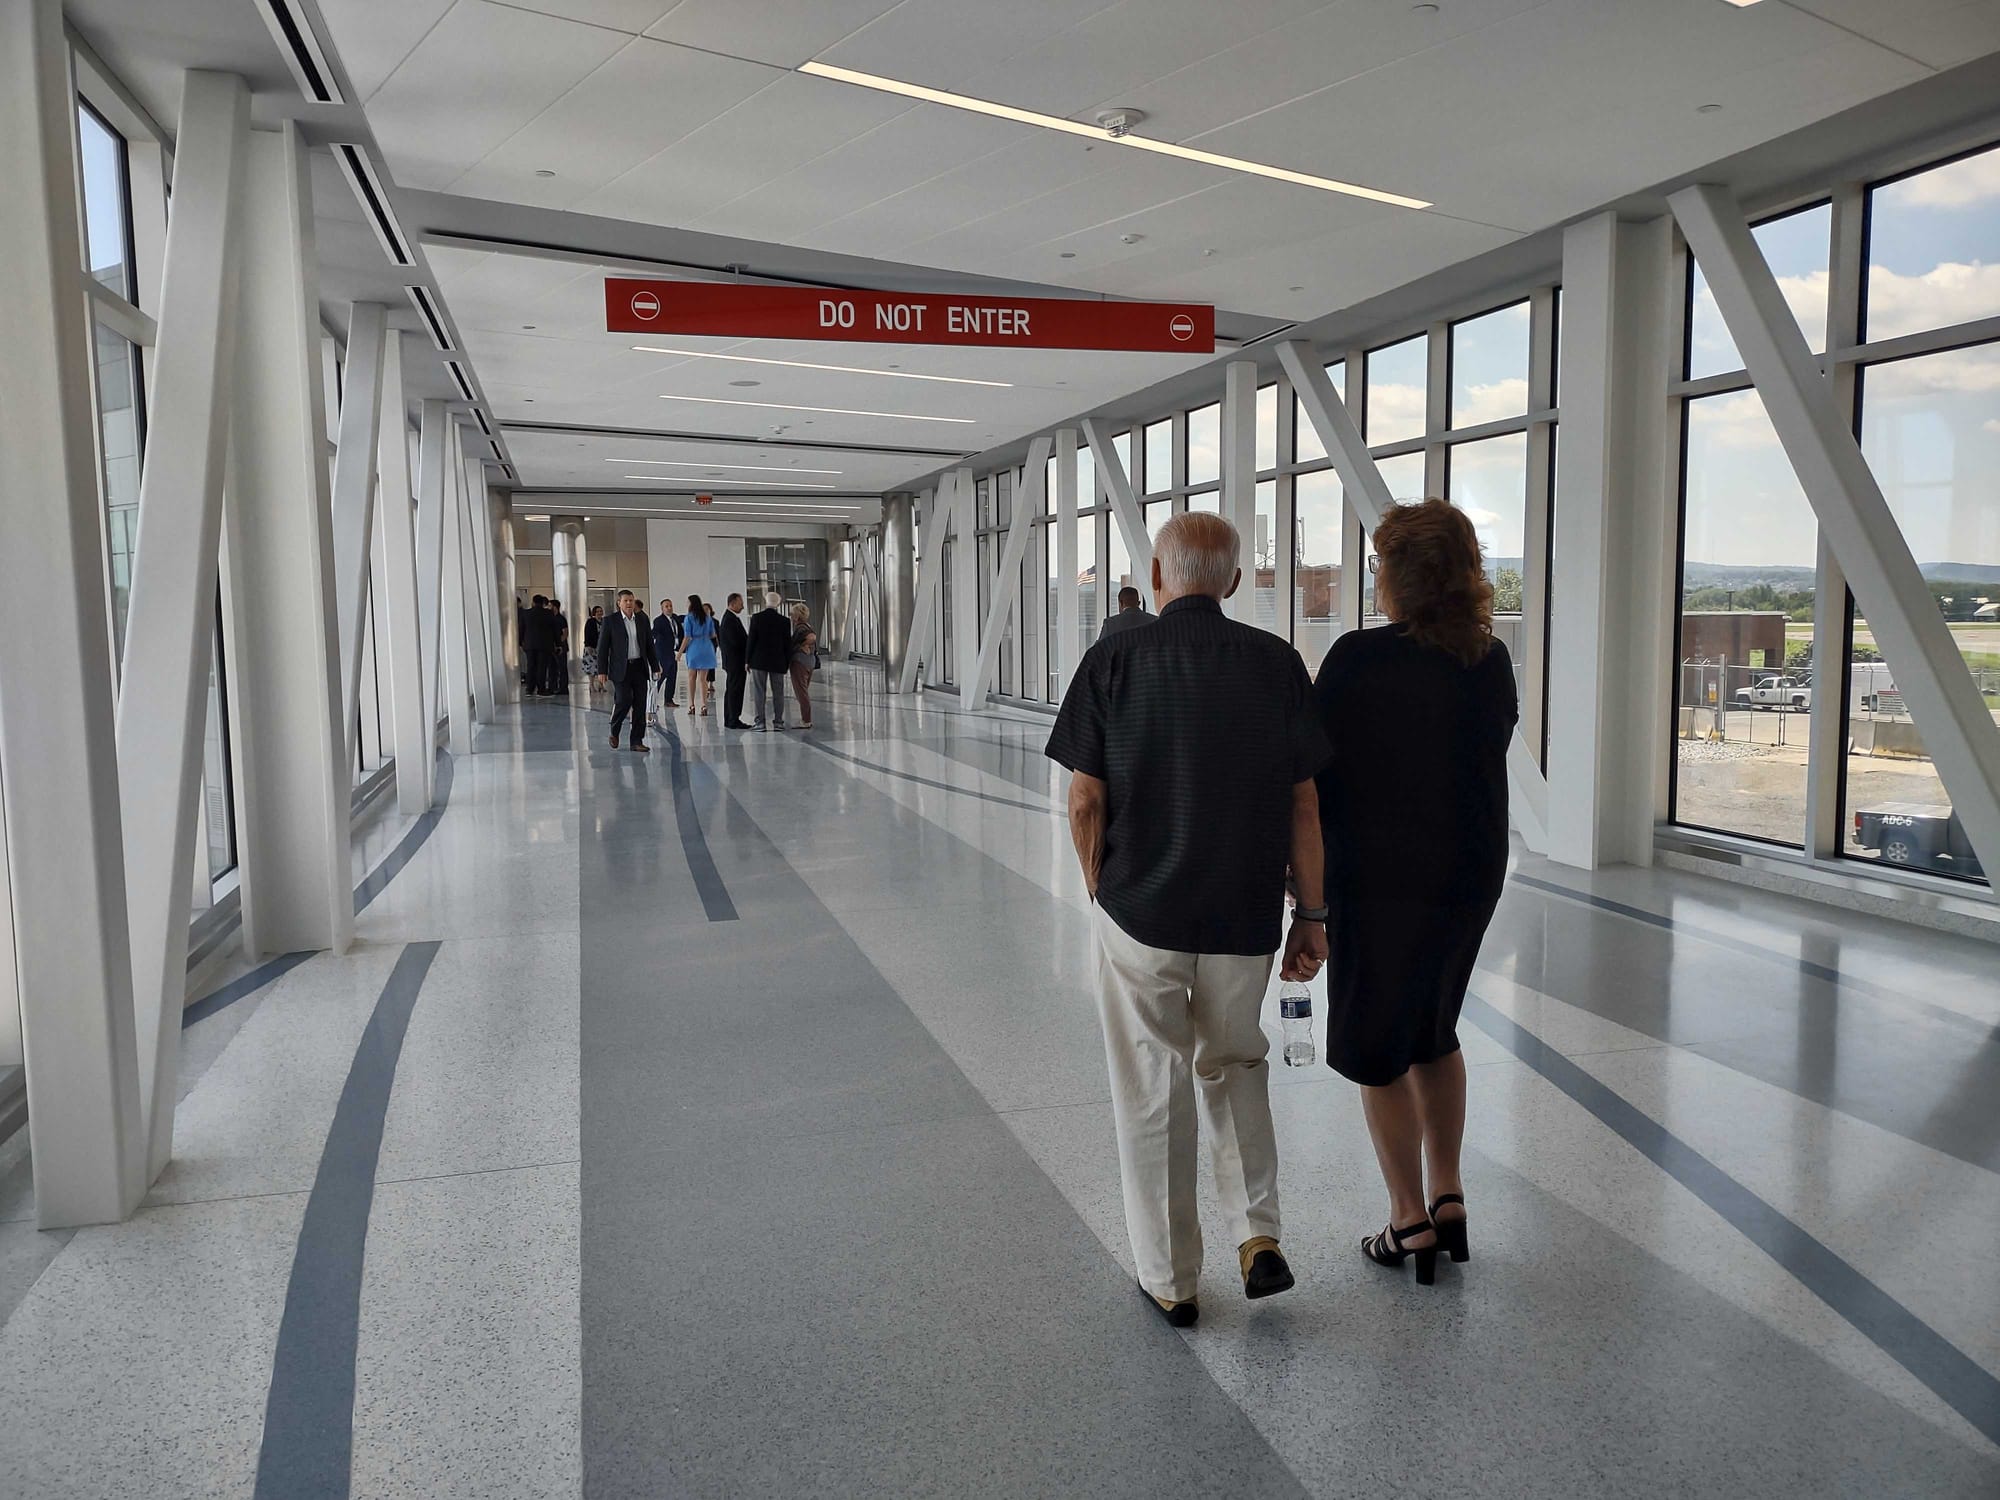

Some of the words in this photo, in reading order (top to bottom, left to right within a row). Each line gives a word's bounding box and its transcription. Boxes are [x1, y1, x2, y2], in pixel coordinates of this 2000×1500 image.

[820, 301, 855, 327] DO
[876, 304, 927, 330] NOT
[948, 307, 1031, 335] ENTER
